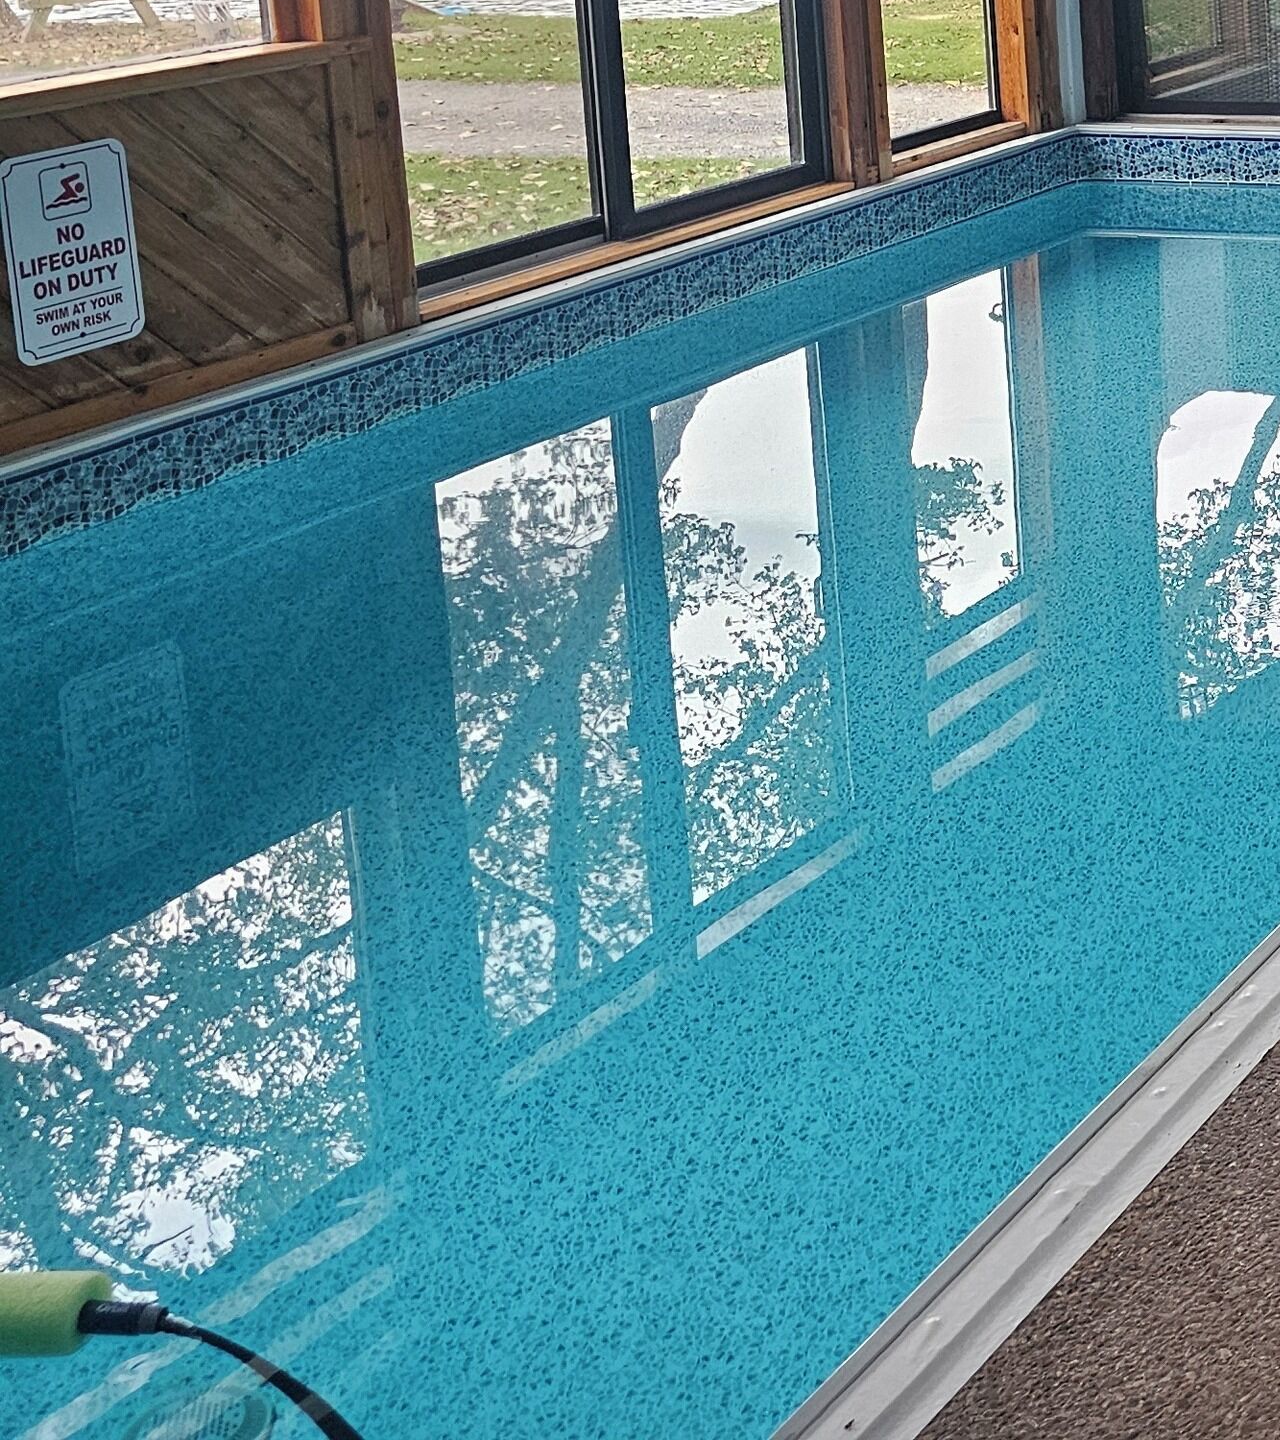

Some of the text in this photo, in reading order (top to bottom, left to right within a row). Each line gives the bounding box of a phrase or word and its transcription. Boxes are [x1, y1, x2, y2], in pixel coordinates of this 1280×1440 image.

[57, 222, 85, 245] NO
[19, 237, 127, 280] LIFEGUARD
[33, 263, 119, 300] ON DUTY
[36, 292, 123, 325] SWIM AT YOUR
[52, 310, 112, 336] OWN RISK
